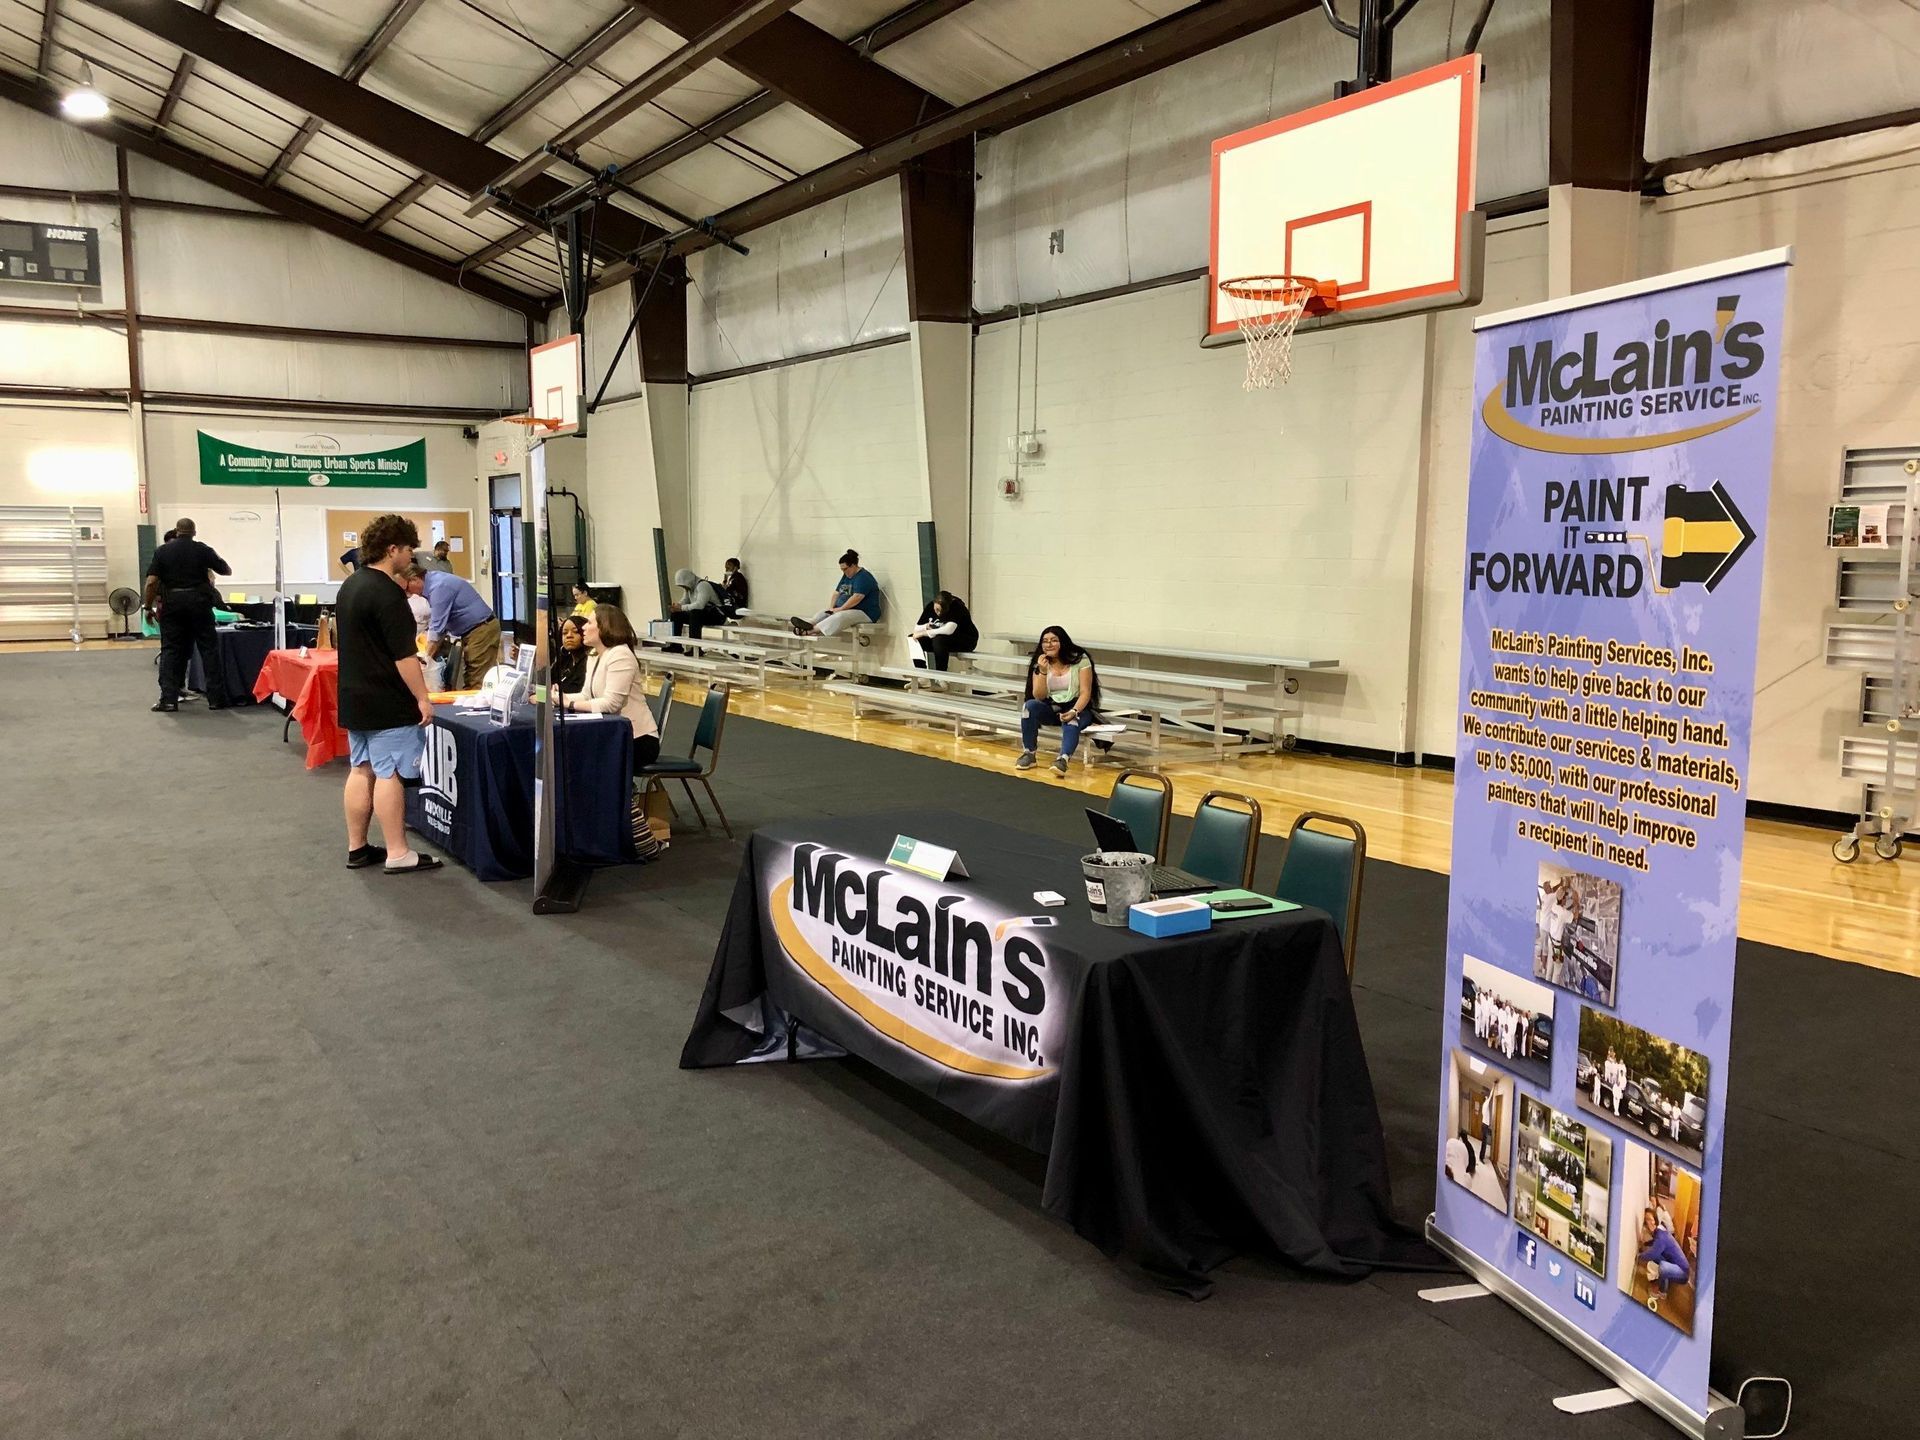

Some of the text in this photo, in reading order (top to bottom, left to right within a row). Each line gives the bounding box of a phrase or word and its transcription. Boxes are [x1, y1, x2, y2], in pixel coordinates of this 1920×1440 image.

[46, 228, 87, 241] HOME
[1506, 295, 1765, 408] McLain's
[1541, 384, 1762, 426] PAINTING SERVICE INC.
[220, 454, 226, 466] A
[228, 454, 272, 470] Community
[275, 457, 289, 468] and
[292, 457, 321, 471] Campus
[324, 457, 347, 469] Urban
[350, 458, 375, 472] Sports
[378, 458, 408, 473] Ministry
[1544, 476, 1649, 522] PAINT
[1564, 526, 1580, 548] IT
[1470, 552, 1643, 598] FORWARD
[1492, 630, 1713, 672] McLain's Painting Services, Inc.
[1494, 664, 1706, 707] wants to help give back to our
[1471, 690, 1728, 746] community with a little helping hand.
[1464, 715, 1739, 790] We contribute our services & materials,
[1477, 750, 1716, 817] up to $5,000, with our professional
[1488, 782, 1696, 848] painters that will help improve
[1519, 821, 1648, 870] a recipient in need.
[793, 843, 1046, 1015] McLain's
[832, 935, 1044, 1067] PAINTING SERVICE INC.
